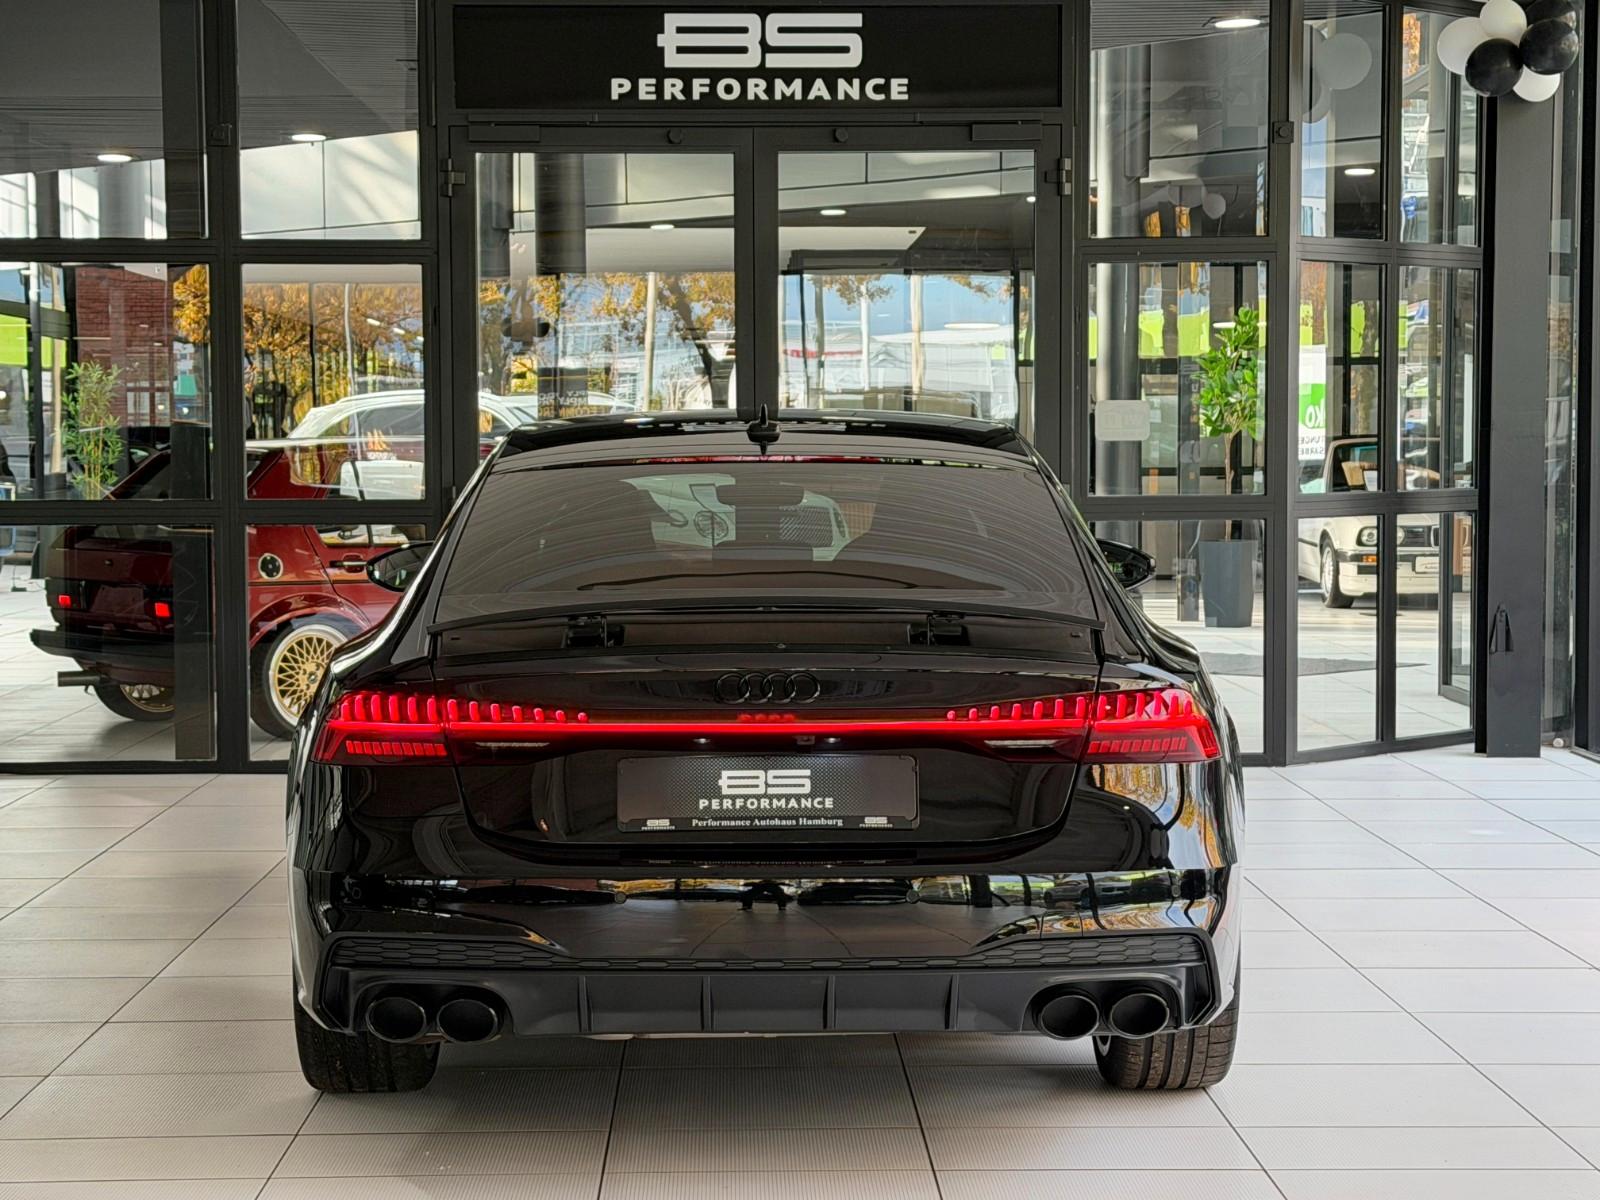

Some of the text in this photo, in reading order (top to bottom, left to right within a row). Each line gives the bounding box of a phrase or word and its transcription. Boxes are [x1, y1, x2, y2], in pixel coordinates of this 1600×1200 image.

[657, 13, 863, 68] BS
[610, 78, 909, 101] PERFORMANCE
[719, 769, 811, 795] BS
[699, 797, 834, 810] PERFORMANCE
[691, 817, 843, 827] Performance Autohaus Hamburg
